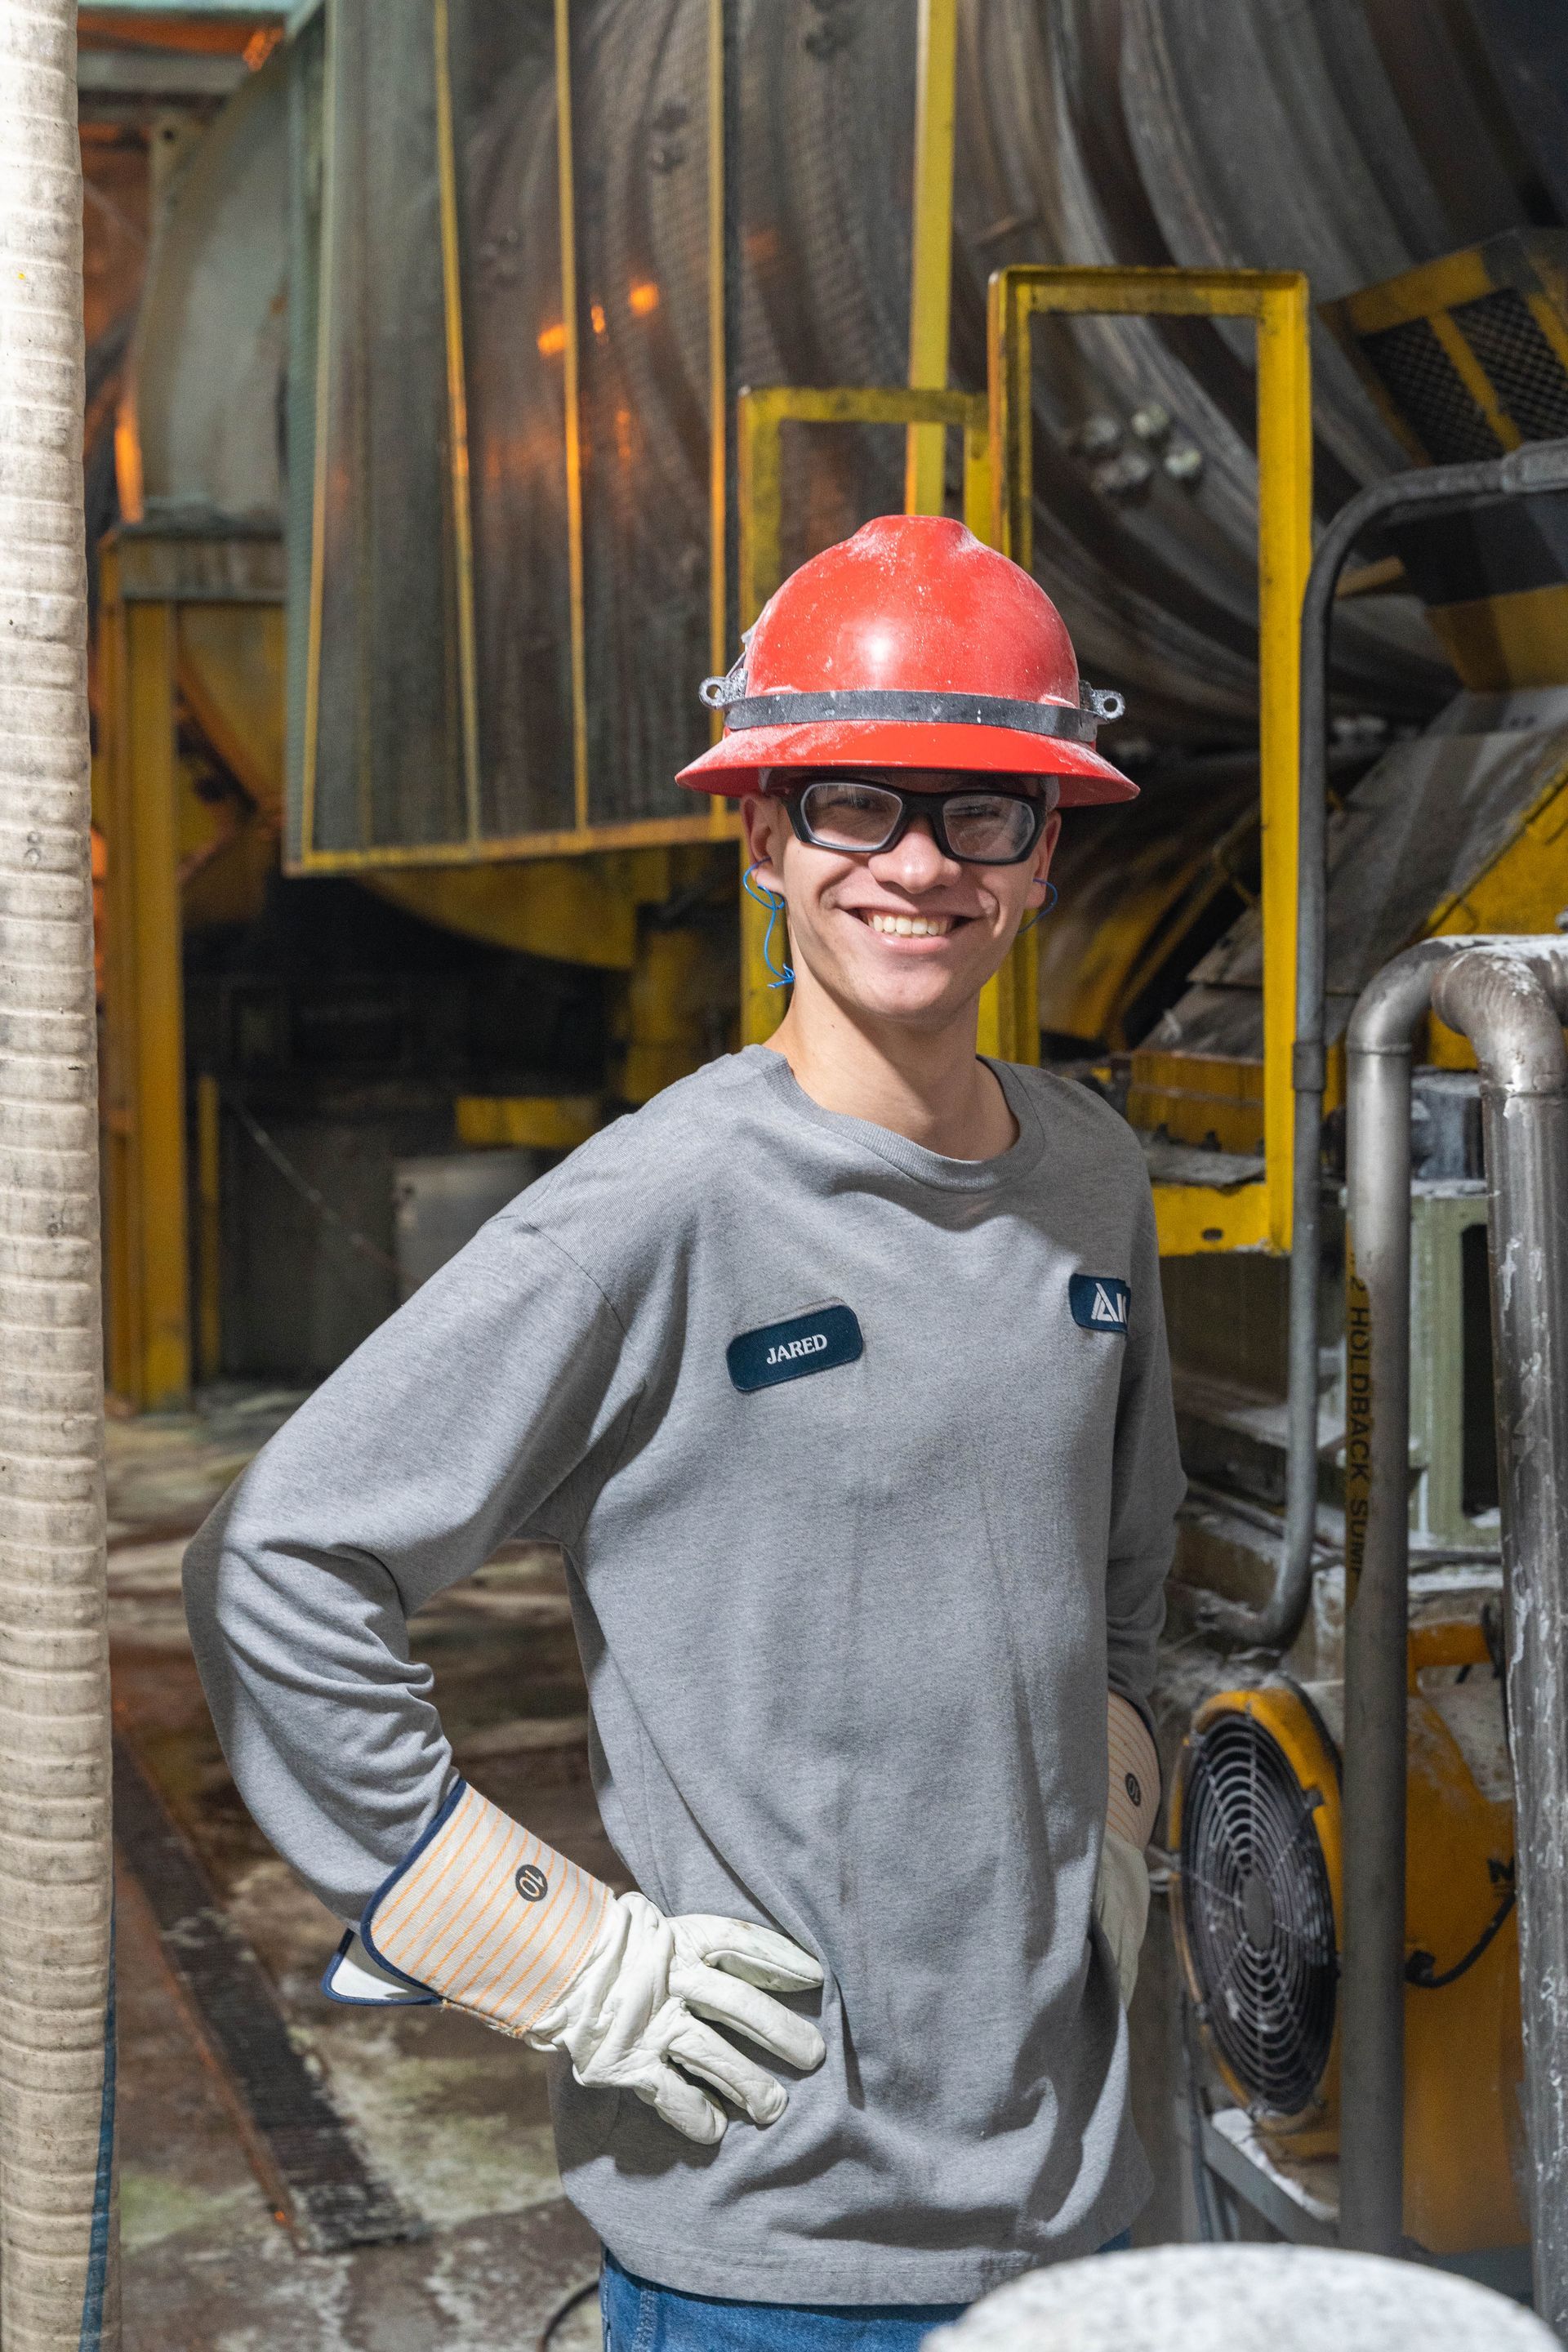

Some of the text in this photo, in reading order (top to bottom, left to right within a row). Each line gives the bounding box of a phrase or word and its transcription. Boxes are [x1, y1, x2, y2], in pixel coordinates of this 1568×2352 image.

[766, 1334, 828, 1365] JARED
[1350, 1307, 1370, 1481] HOLDBACK
[519, 1869, 545, 1897] 10
